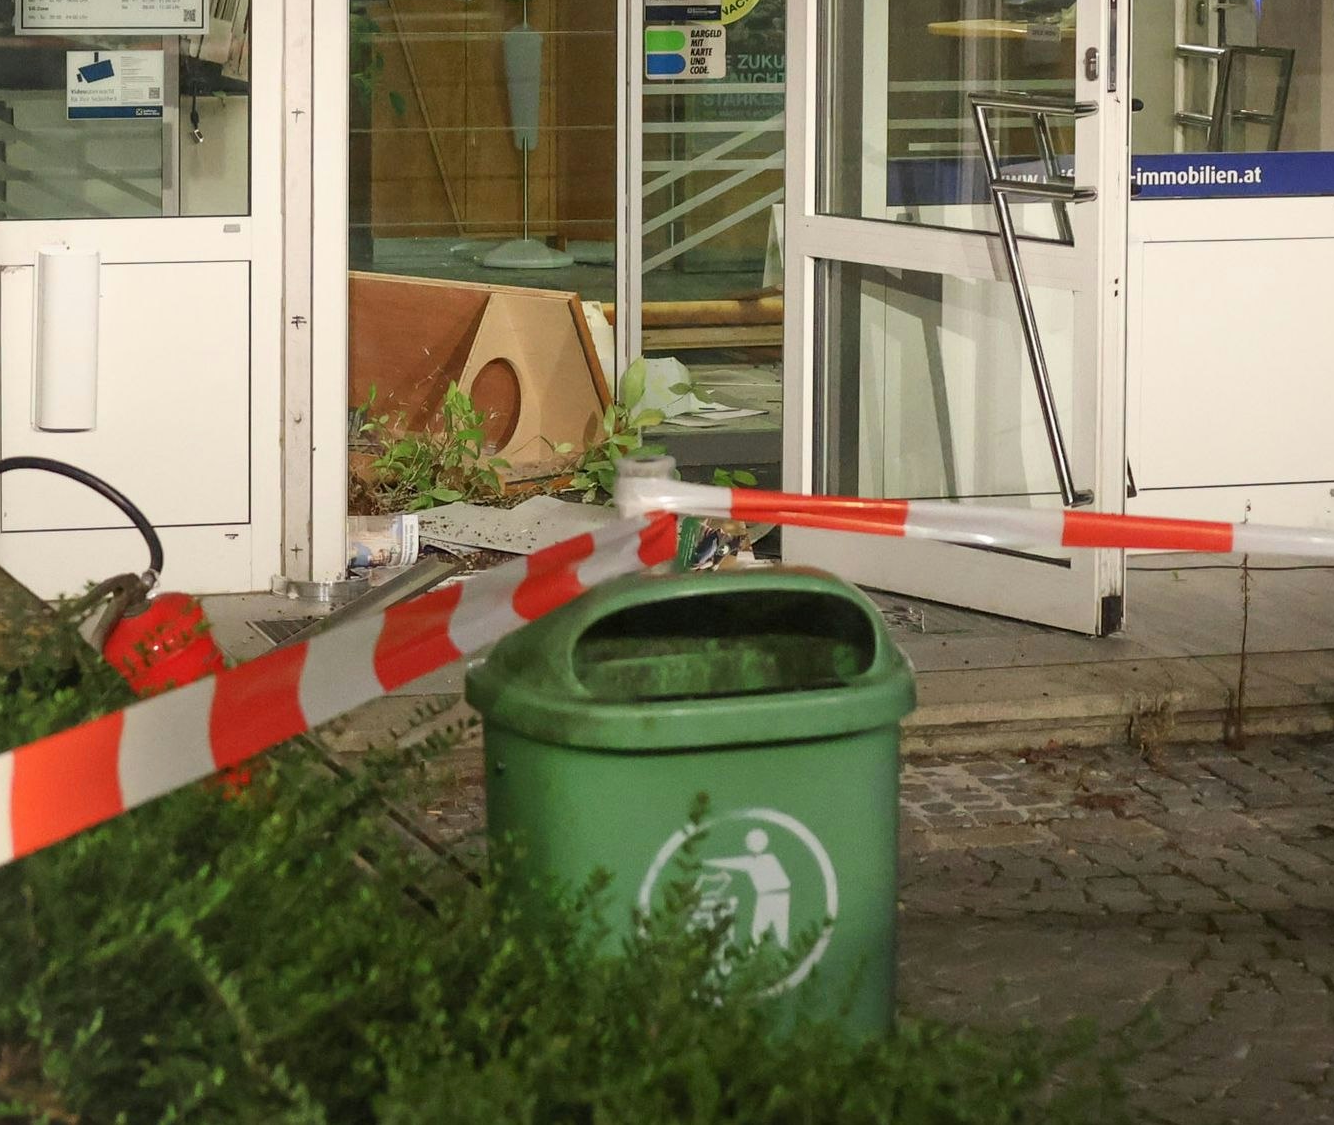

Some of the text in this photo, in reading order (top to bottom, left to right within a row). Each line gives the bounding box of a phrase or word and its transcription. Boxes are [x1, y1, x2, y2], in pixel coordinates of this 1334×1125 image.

[690, 29, 722, 38] BARGELD
[690, 39, 704, 47] MIT
[690, 48, 713, 56] KARTE
[690, 57, 706, 65] UND
